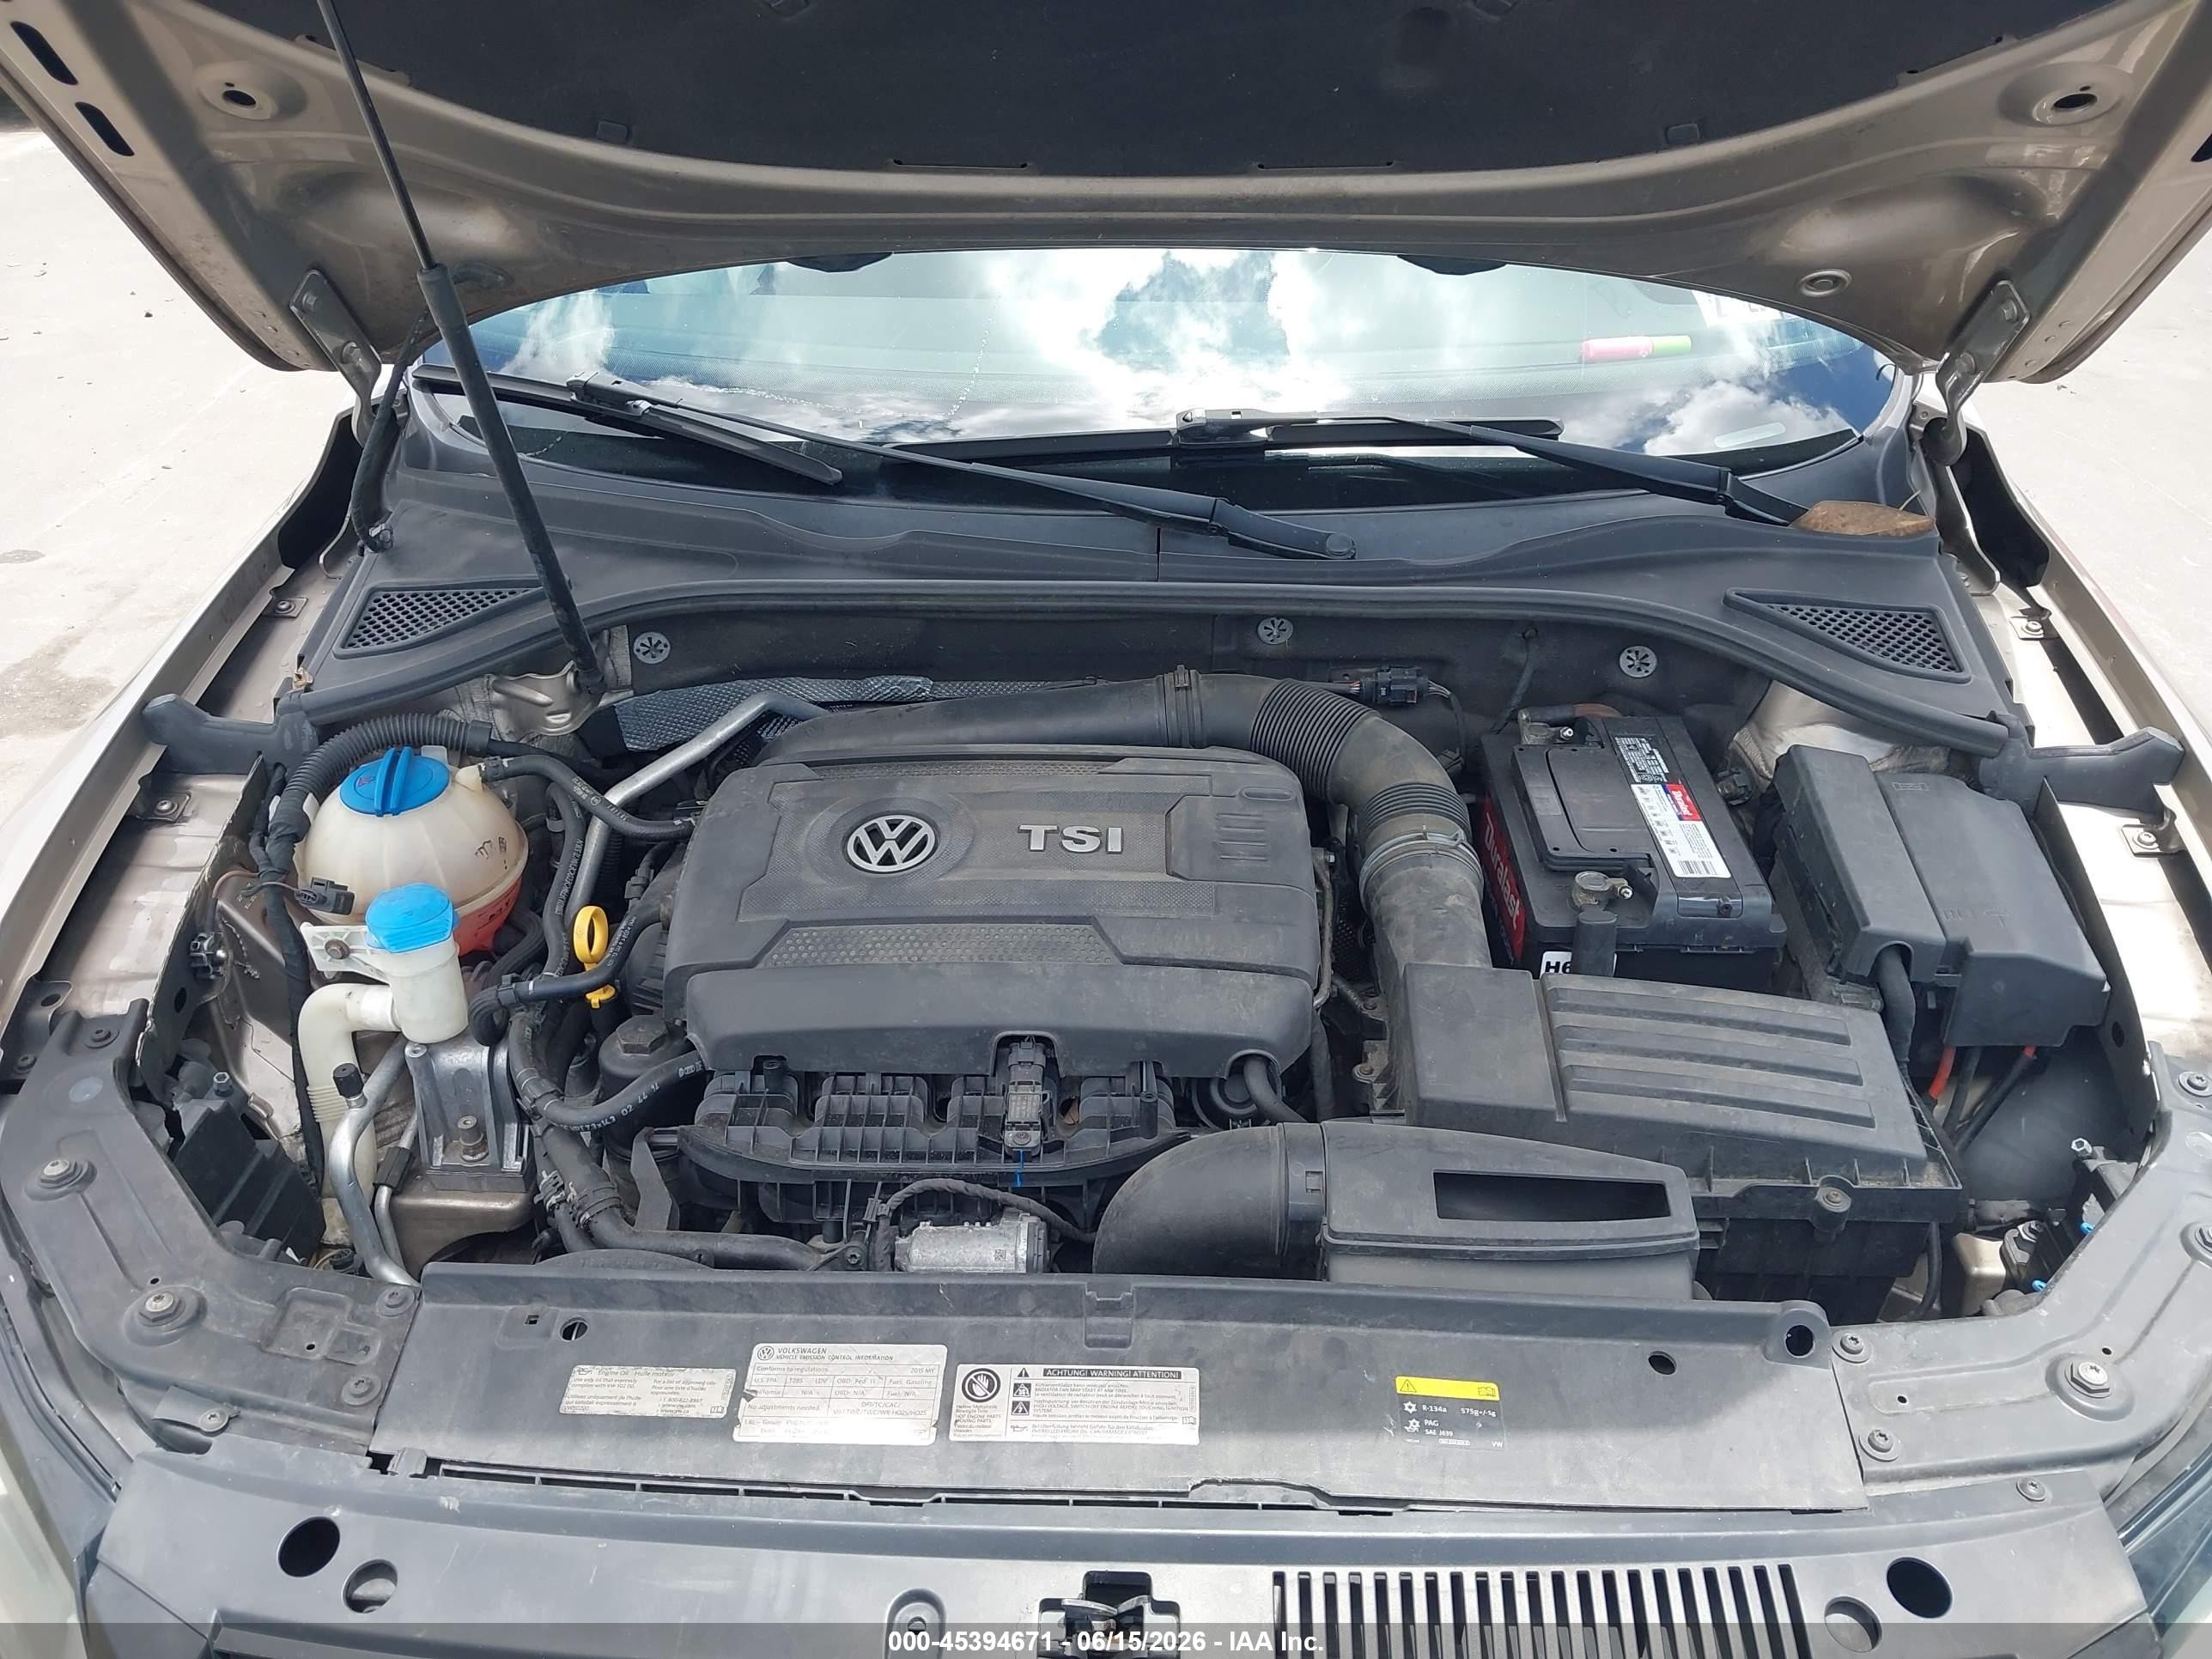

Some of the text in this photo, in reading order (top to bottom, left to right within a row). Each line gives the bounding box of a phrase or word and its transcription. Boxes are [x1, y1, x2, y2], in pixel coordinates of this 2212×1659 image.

[1019, 824, 1122, 854] TSI
[1485, 811, 1520, 930] Duralast
[1046, 1369, 1179, 1379] ACHTUNG! WARNING! ATTENTION!
[1422, 1404, 1448, 1413] R-134a
[1424, 1419, 1439, 1427] PAG
[1492, 1440, 1504, 1449] VW
